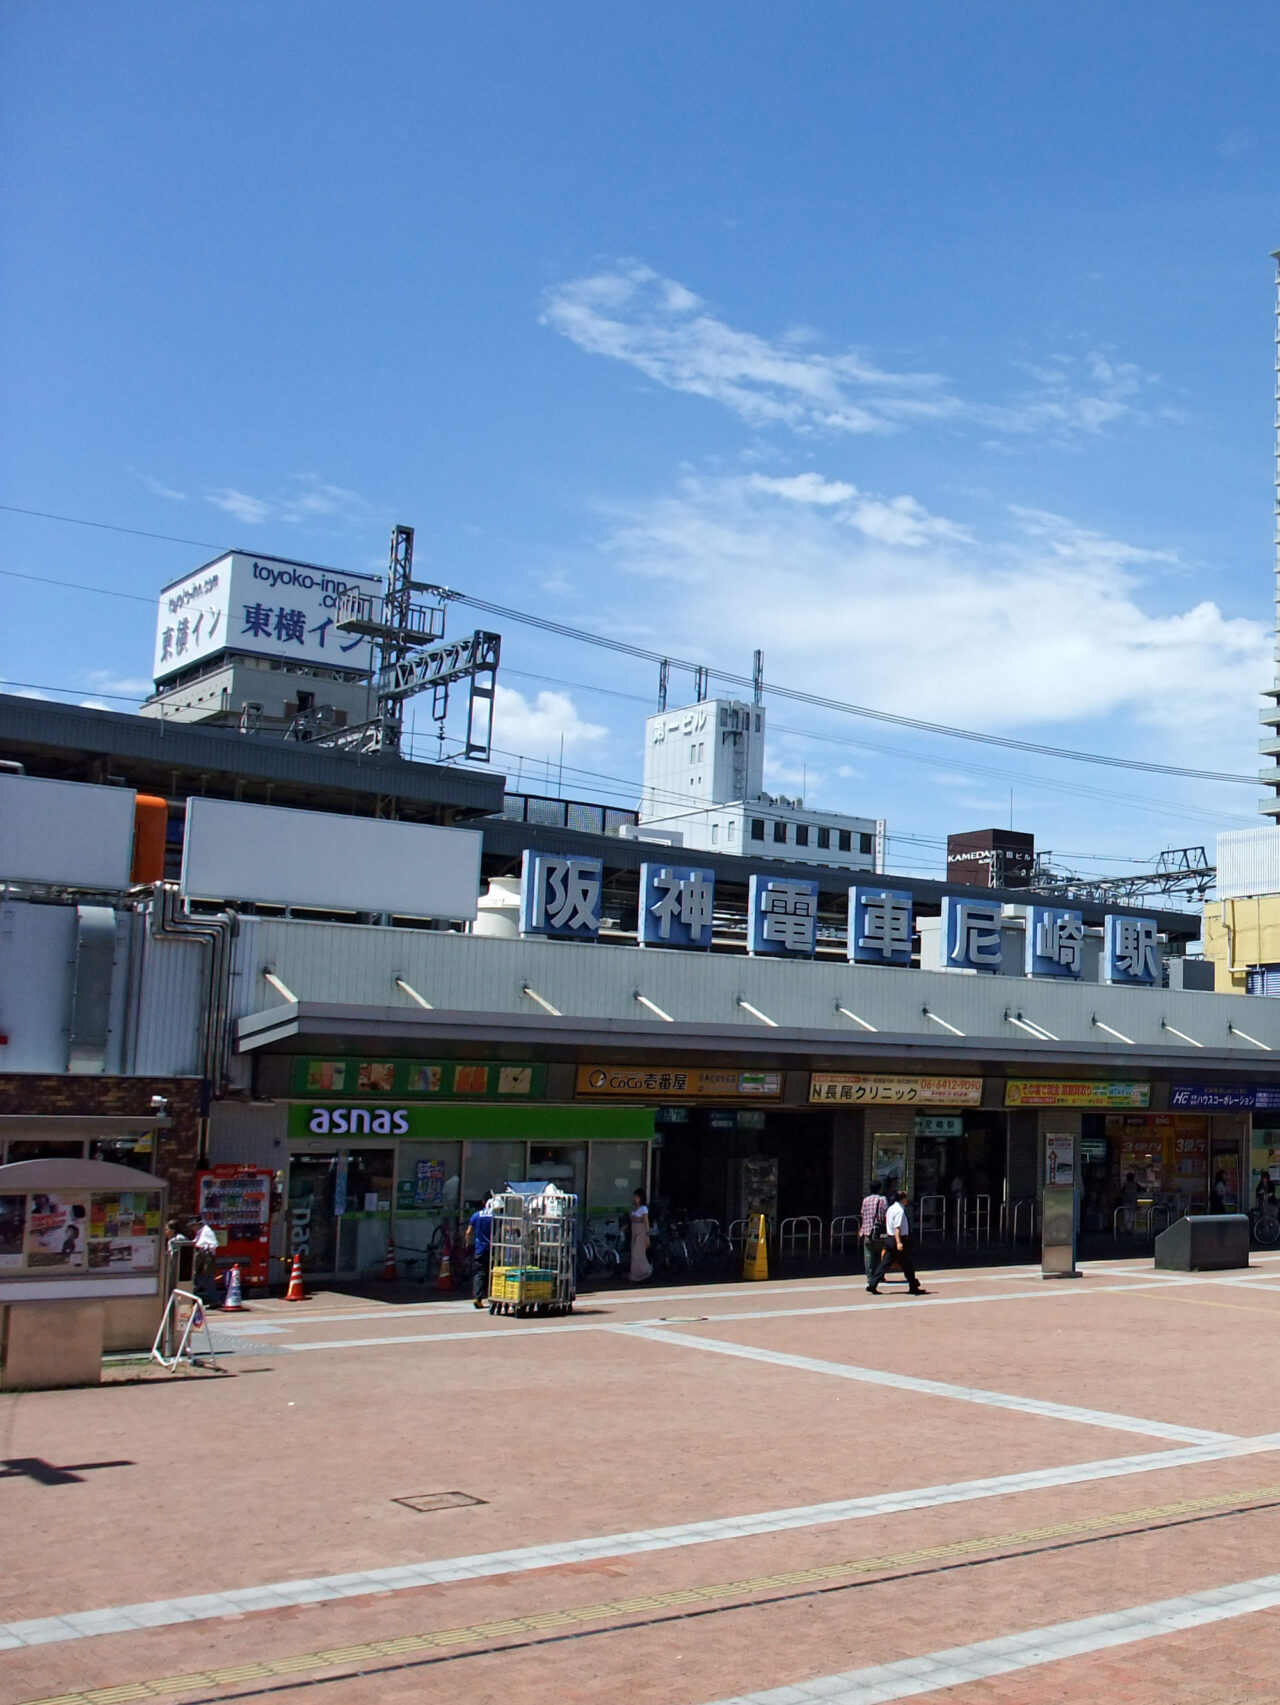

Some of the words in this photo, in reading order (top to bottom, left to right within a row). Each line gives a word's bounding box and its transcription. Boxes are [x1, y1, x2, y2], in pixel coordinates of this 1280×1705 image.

[253, 562, 347, 594] toyoko-inn
[161, 606, 222, 662] 東横イン
[653, 709, 707, 744] 第一ビル
[947, 850, 992, 863] KAMEDA
[532, 857, 1158, 977] 阪神電車尼崎駅
[610, 1073, 688, 1091] CoCo壱番屋
[826, 1084, 917, 1101] 長尾クリニック
[921, 1078, 981, 1091] 06-6412-9090
[309, 1108, 409, 1135] asnas
